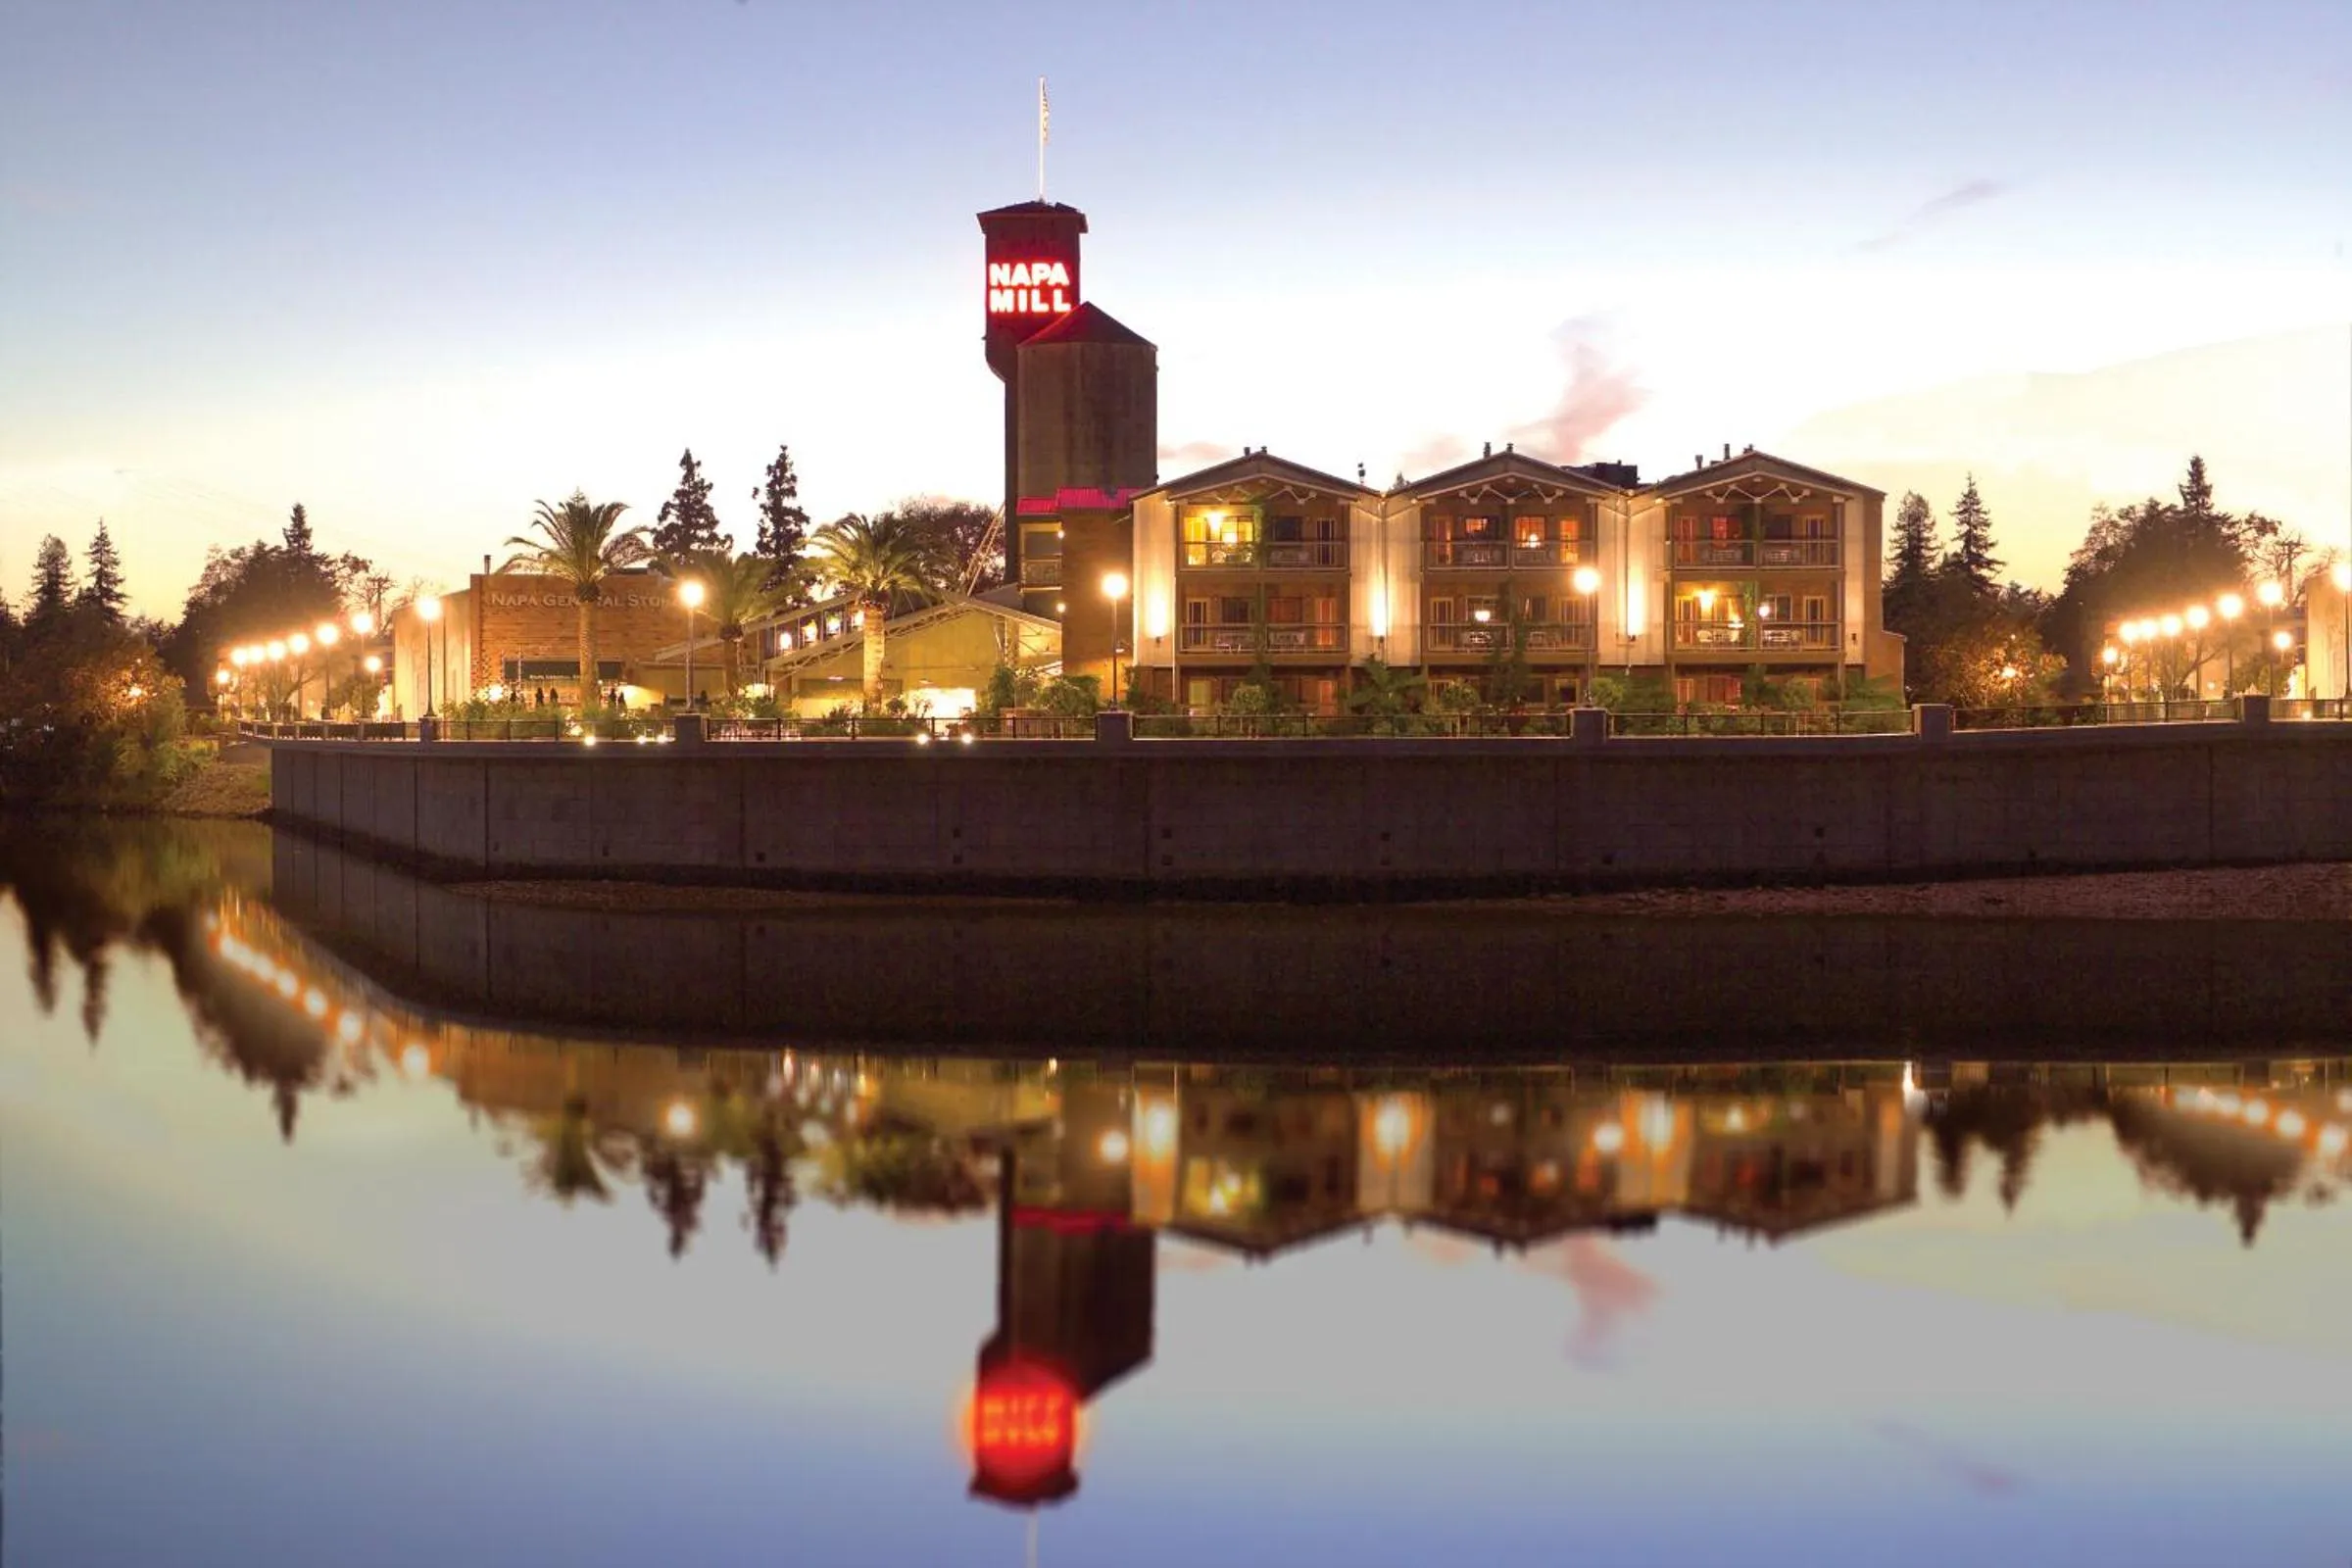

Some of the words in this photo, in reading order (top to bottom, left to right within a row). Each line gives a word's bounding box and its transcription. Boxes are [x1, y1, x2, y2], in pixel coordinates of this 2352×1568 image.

[989, 262, 1070, 286] NAPA
[989, 288, 1072, 314] MILL
[491, 593, 538, 607] NAPA
[543, 594, 625, 608] GENAL
